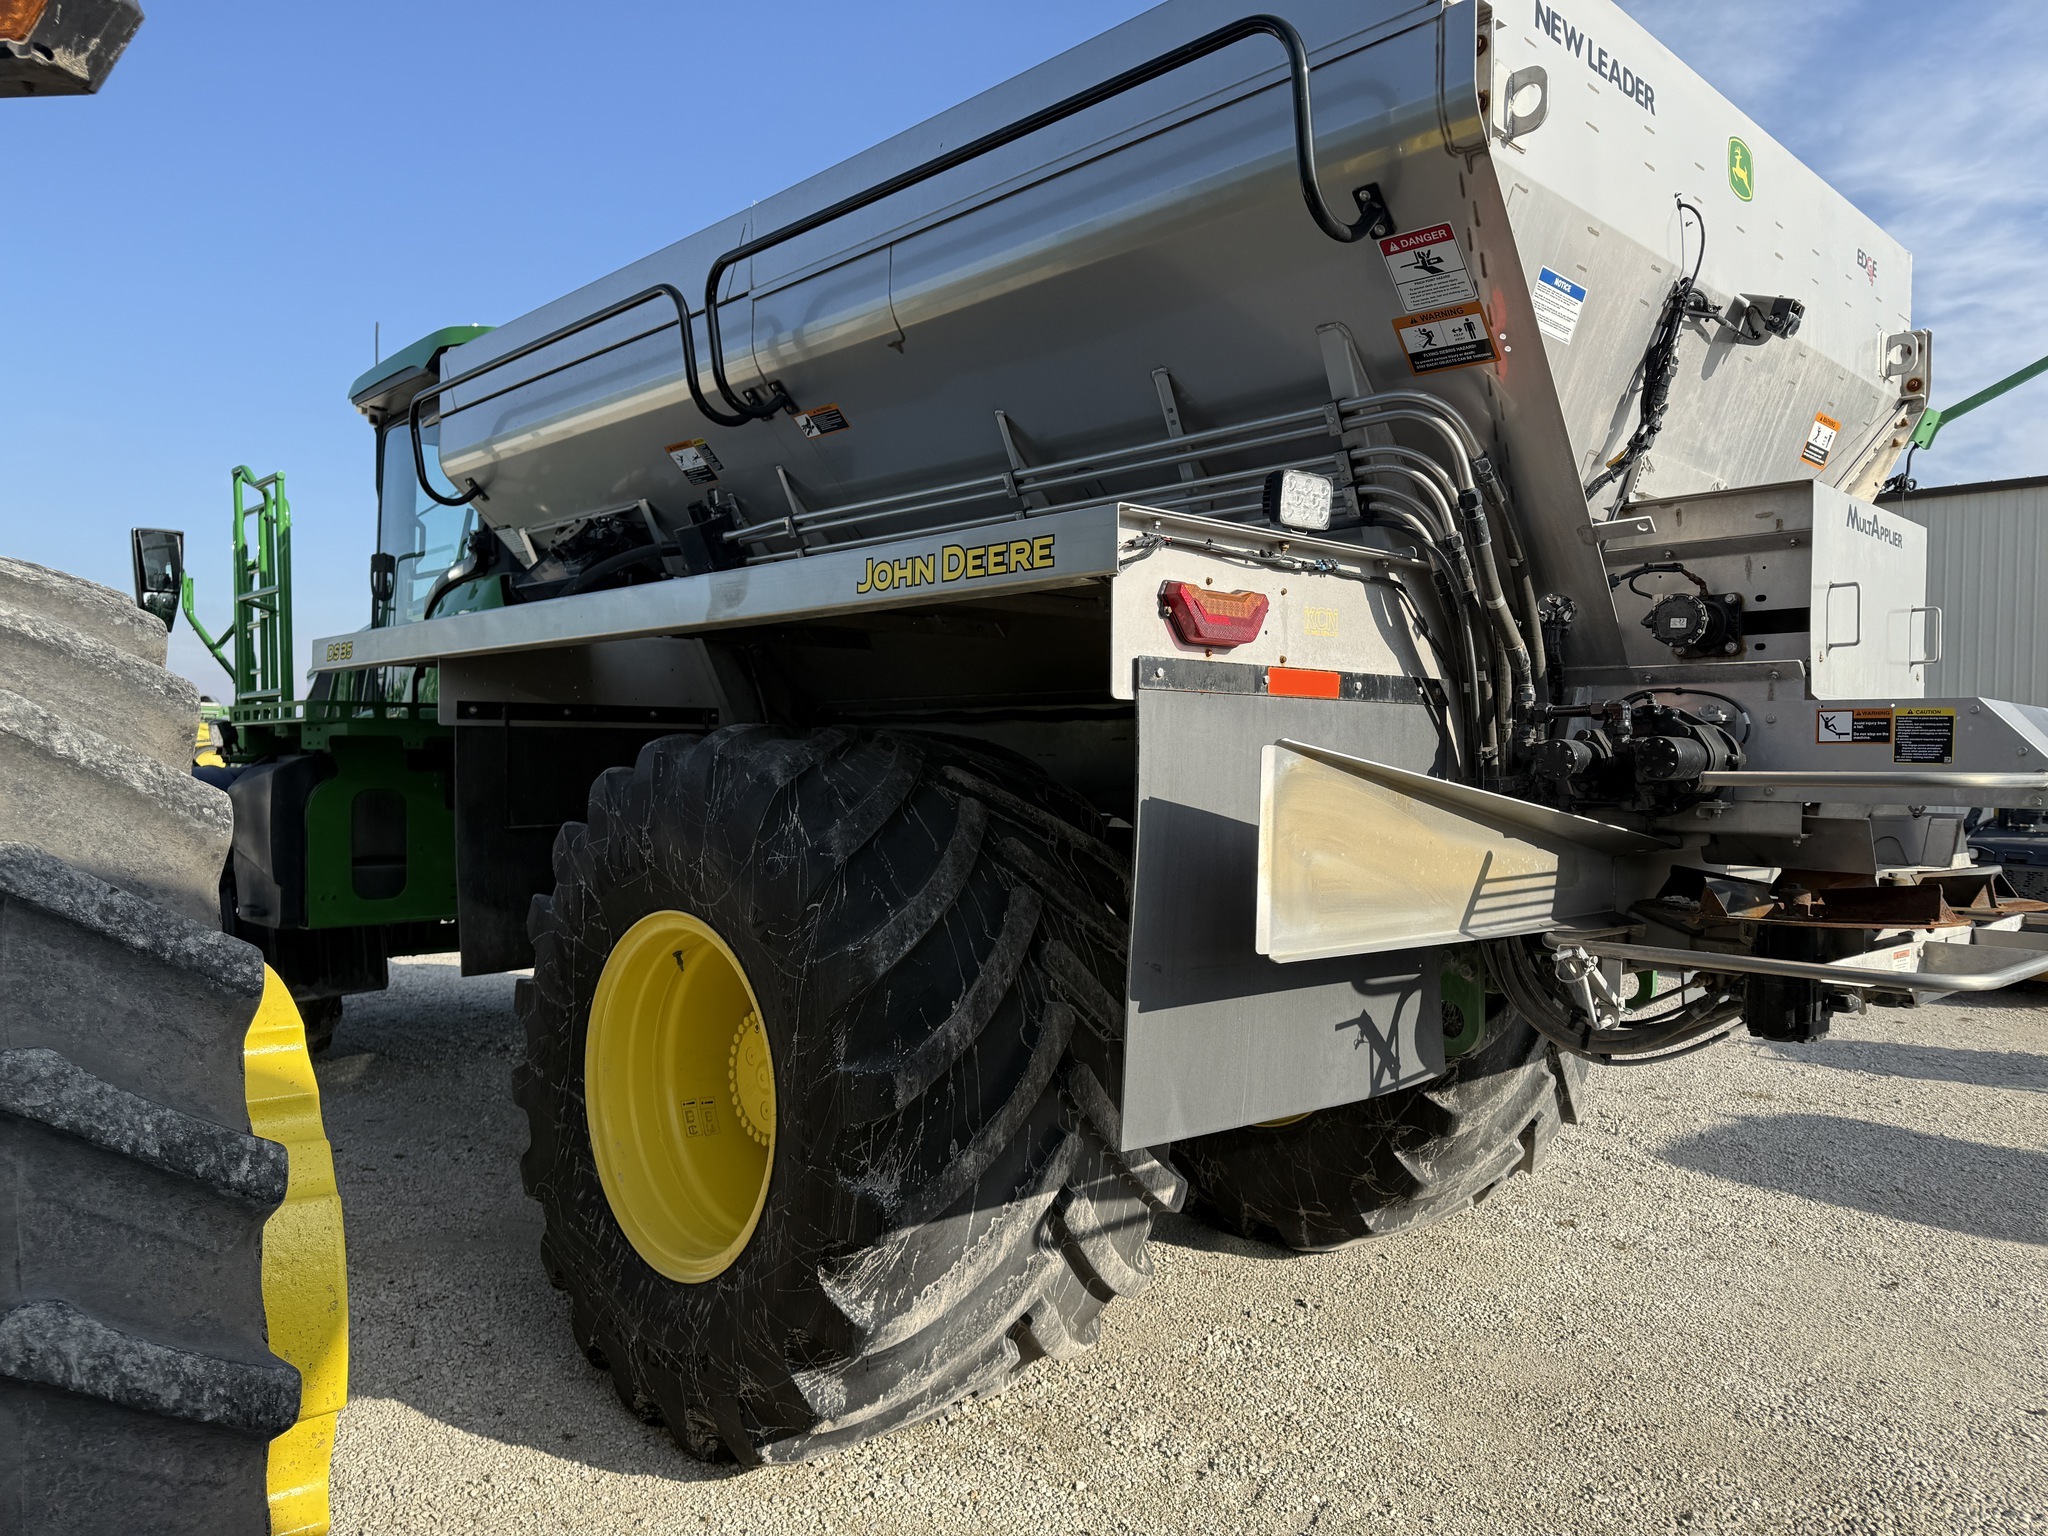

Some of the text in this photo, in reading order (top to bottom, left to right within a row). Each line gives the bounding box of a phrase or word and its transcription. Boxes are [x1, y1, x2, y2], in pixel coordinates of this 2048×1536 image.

[1535, 0, 1655, 116] NEW LEADER
[1401, 230, 1447, 248] DANGER
[1554, 278, 1572, 292] NOTICE
[1420, 307, 1464, 322] WARNING
[857, 534, 1055, 594] JOHN DEERE
[1304, 606, 1338, 630] KCN
[327, 641, 353, 662] DS 35
